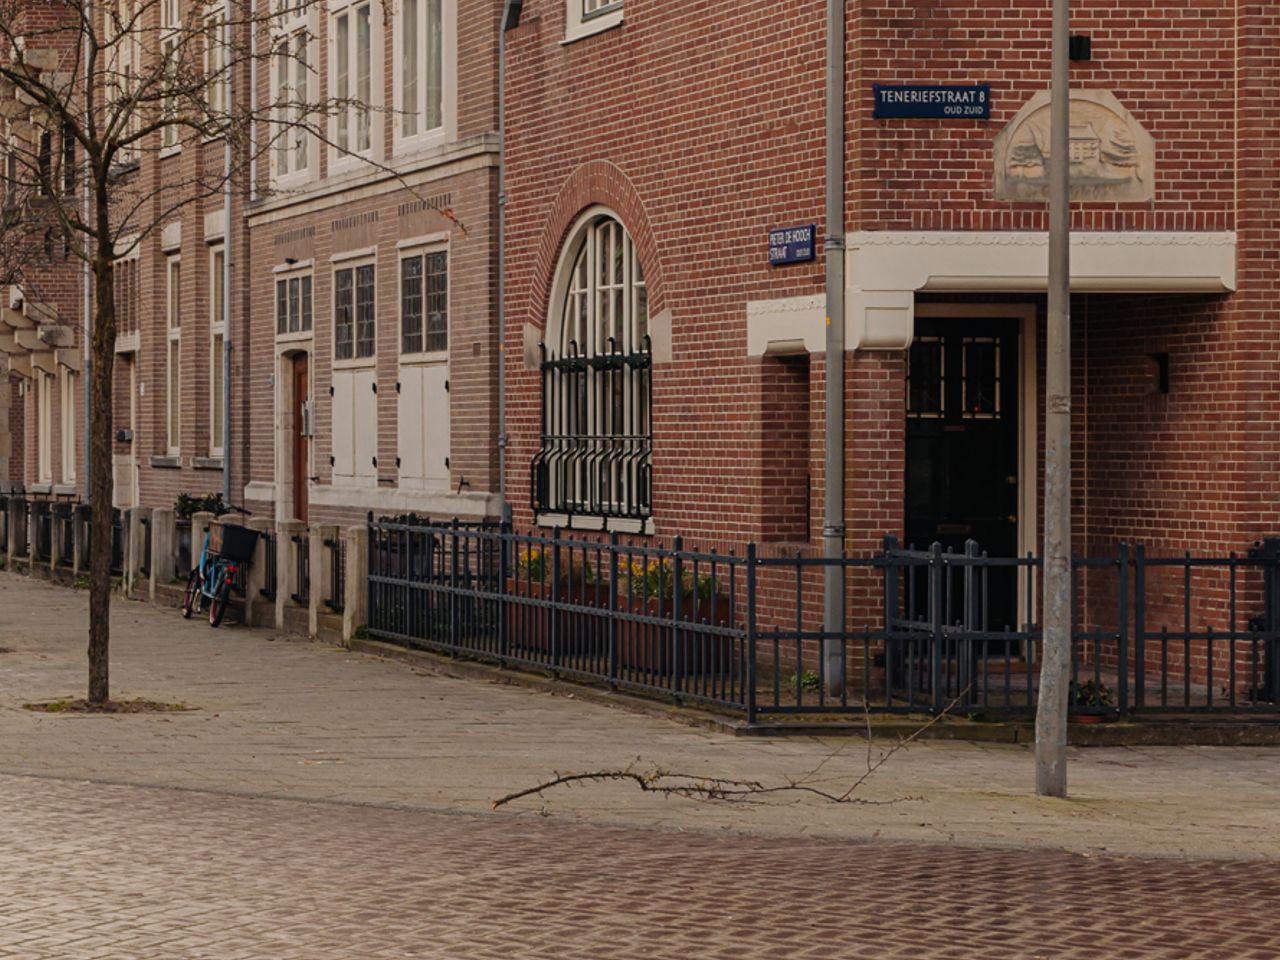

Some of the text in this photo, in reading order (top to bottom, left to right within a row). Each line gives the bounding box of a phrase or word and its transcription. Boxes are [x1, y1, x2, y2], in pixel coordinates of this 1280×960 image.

[880, 90, 985, 103] TENERIEFSTRAAT 8
[944, 106, 984, 114] OUD ZUID
[769, 228, 811, 246] PIETER DE HOOCH
